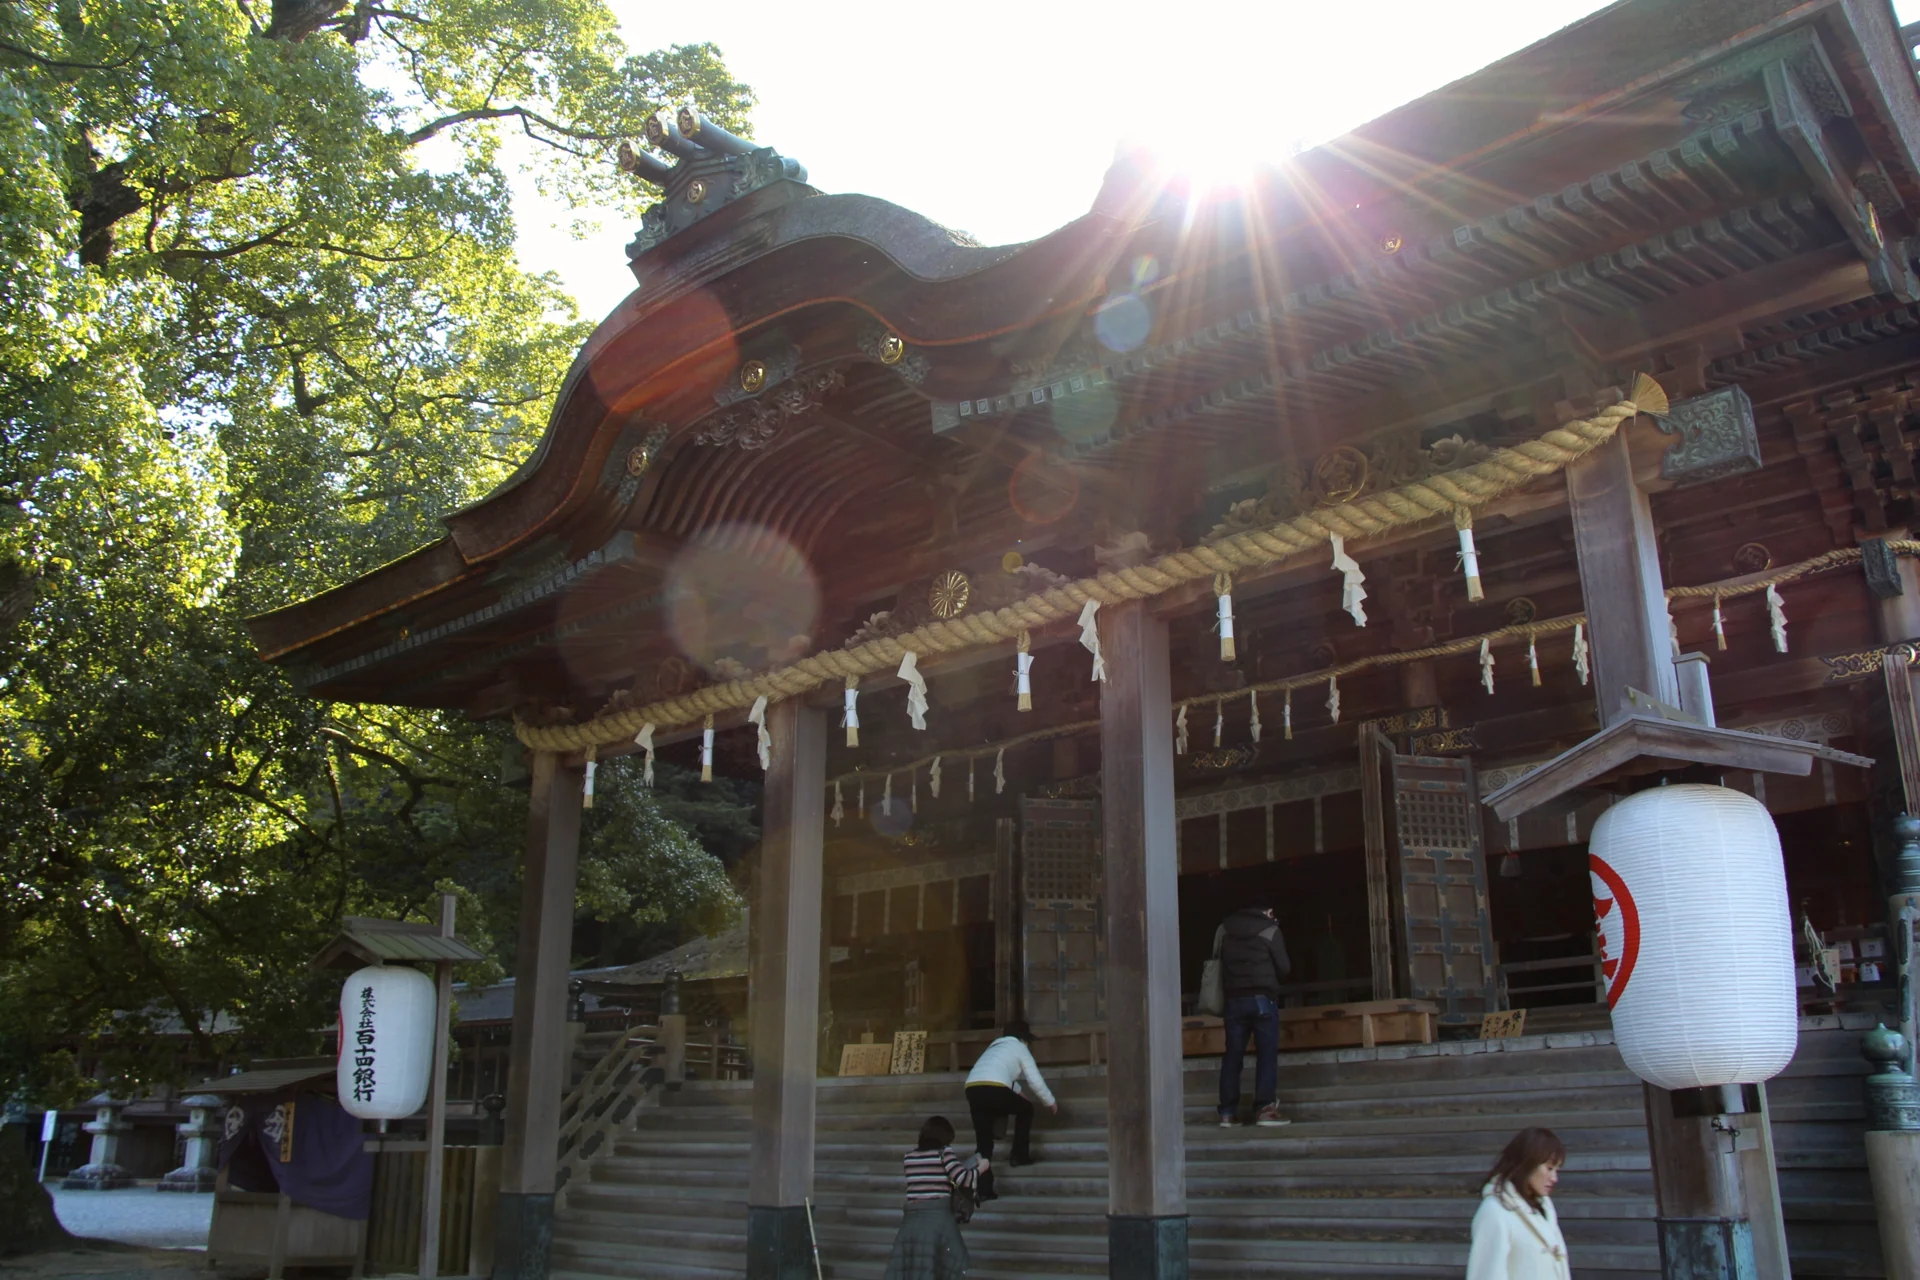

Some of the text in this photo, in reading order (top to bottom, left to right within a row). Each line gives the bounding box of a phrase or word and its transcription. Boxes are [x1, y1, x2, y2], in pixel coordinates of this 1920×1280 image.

[353, 986, 376, 1102] 株式会社百十四銀行
